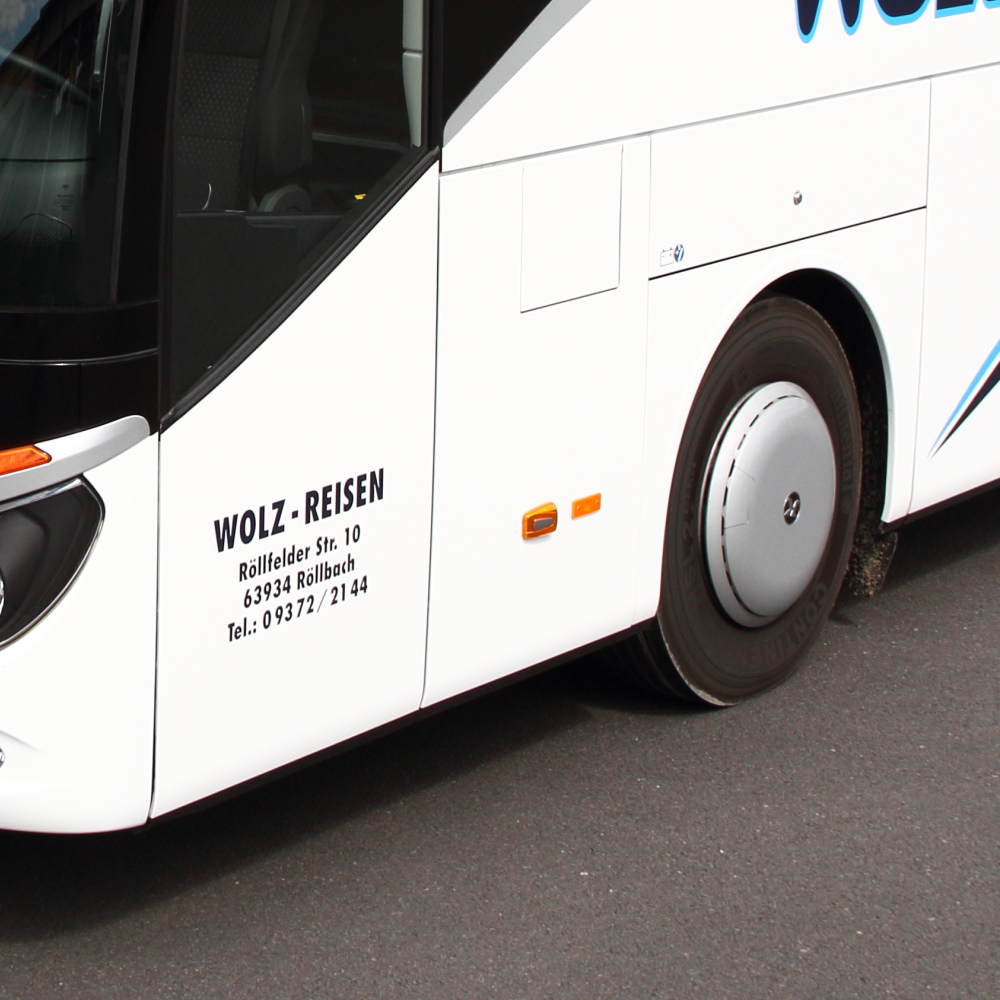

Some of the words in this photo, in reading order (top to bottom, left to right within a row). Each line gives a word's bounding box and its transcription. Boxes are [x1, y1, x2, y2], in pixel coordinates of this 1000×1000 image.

[238, 544, 311, 583] Röllfelder
[315, 535, 338, 557] Str.
[344, 523, 361, 546] 10
[243, 574, 292, 609] 63934
[296, 552, 355, 591] Röllbach
[227, 616, 257, 643] Tel.:
